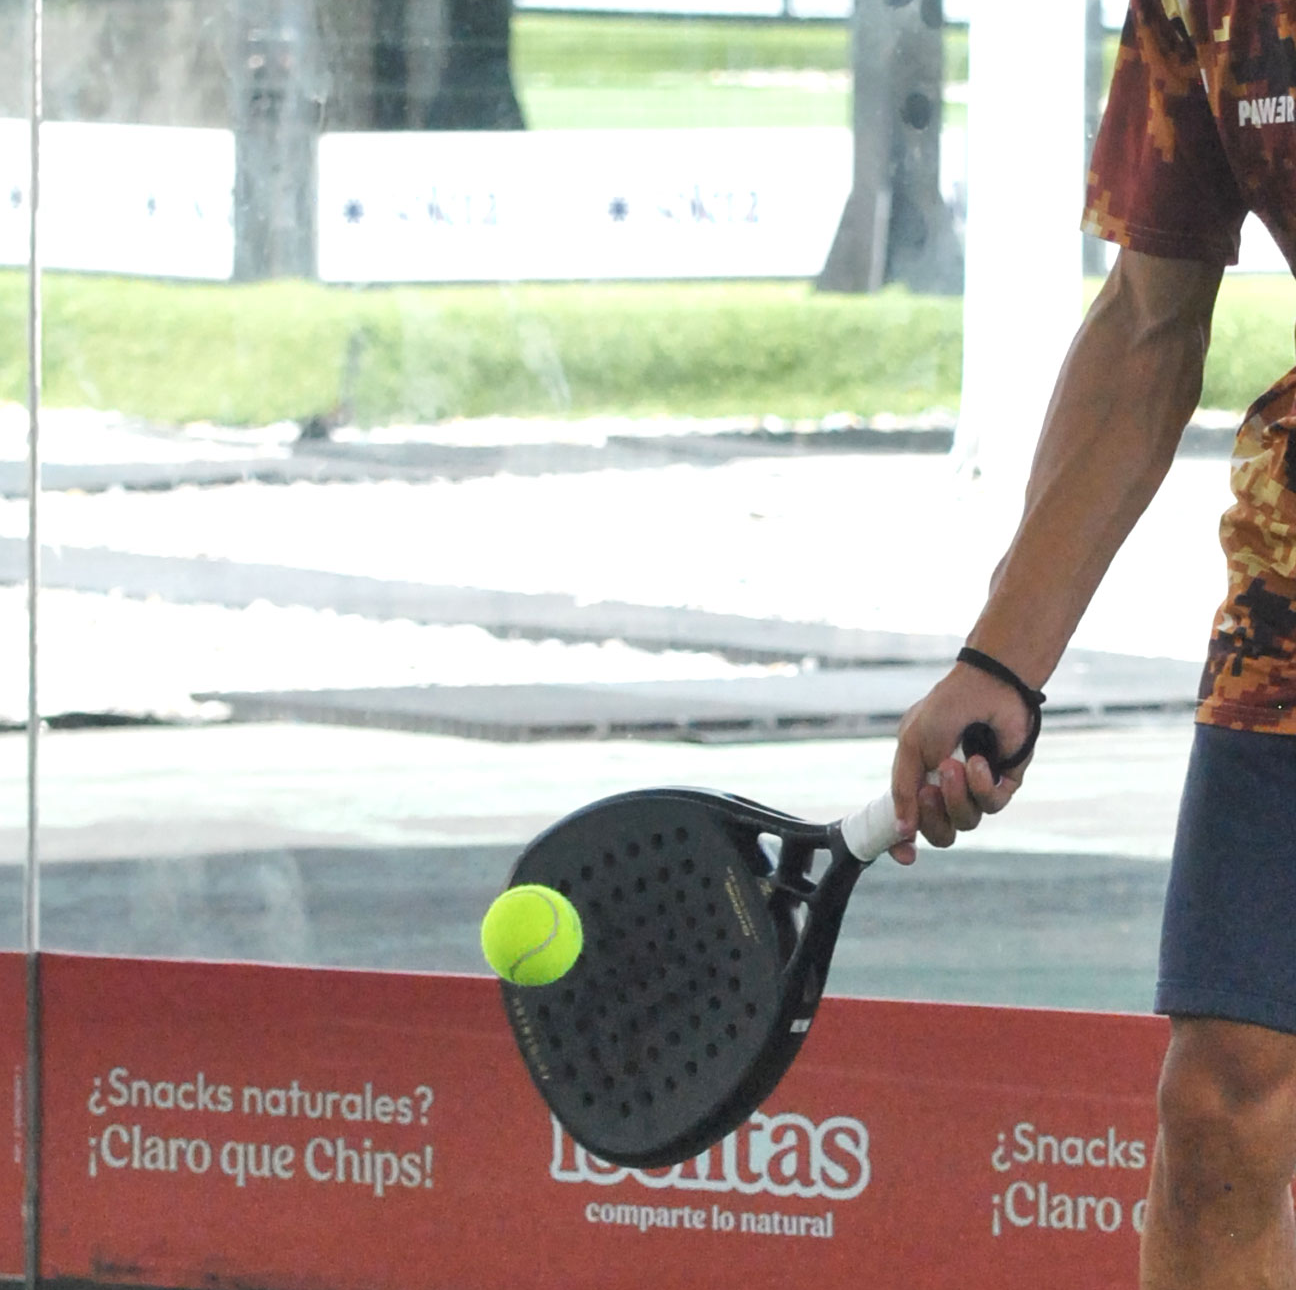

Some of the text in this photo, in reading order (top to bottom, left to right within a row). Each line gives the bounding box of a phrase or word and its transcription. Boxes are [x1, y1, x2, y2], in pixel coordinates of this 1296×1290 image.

[88, 1067, 434, 1126] ¿Snacks naturales?
[88, 1123, 434, 1198] ¡Claro que Chips!
[991, 1122, 1147, 1173] ¿Snacks
[585, 1202, 834, 1238] comparte lo natural
[991, 1180, 1123, 1237] ¡Claro
